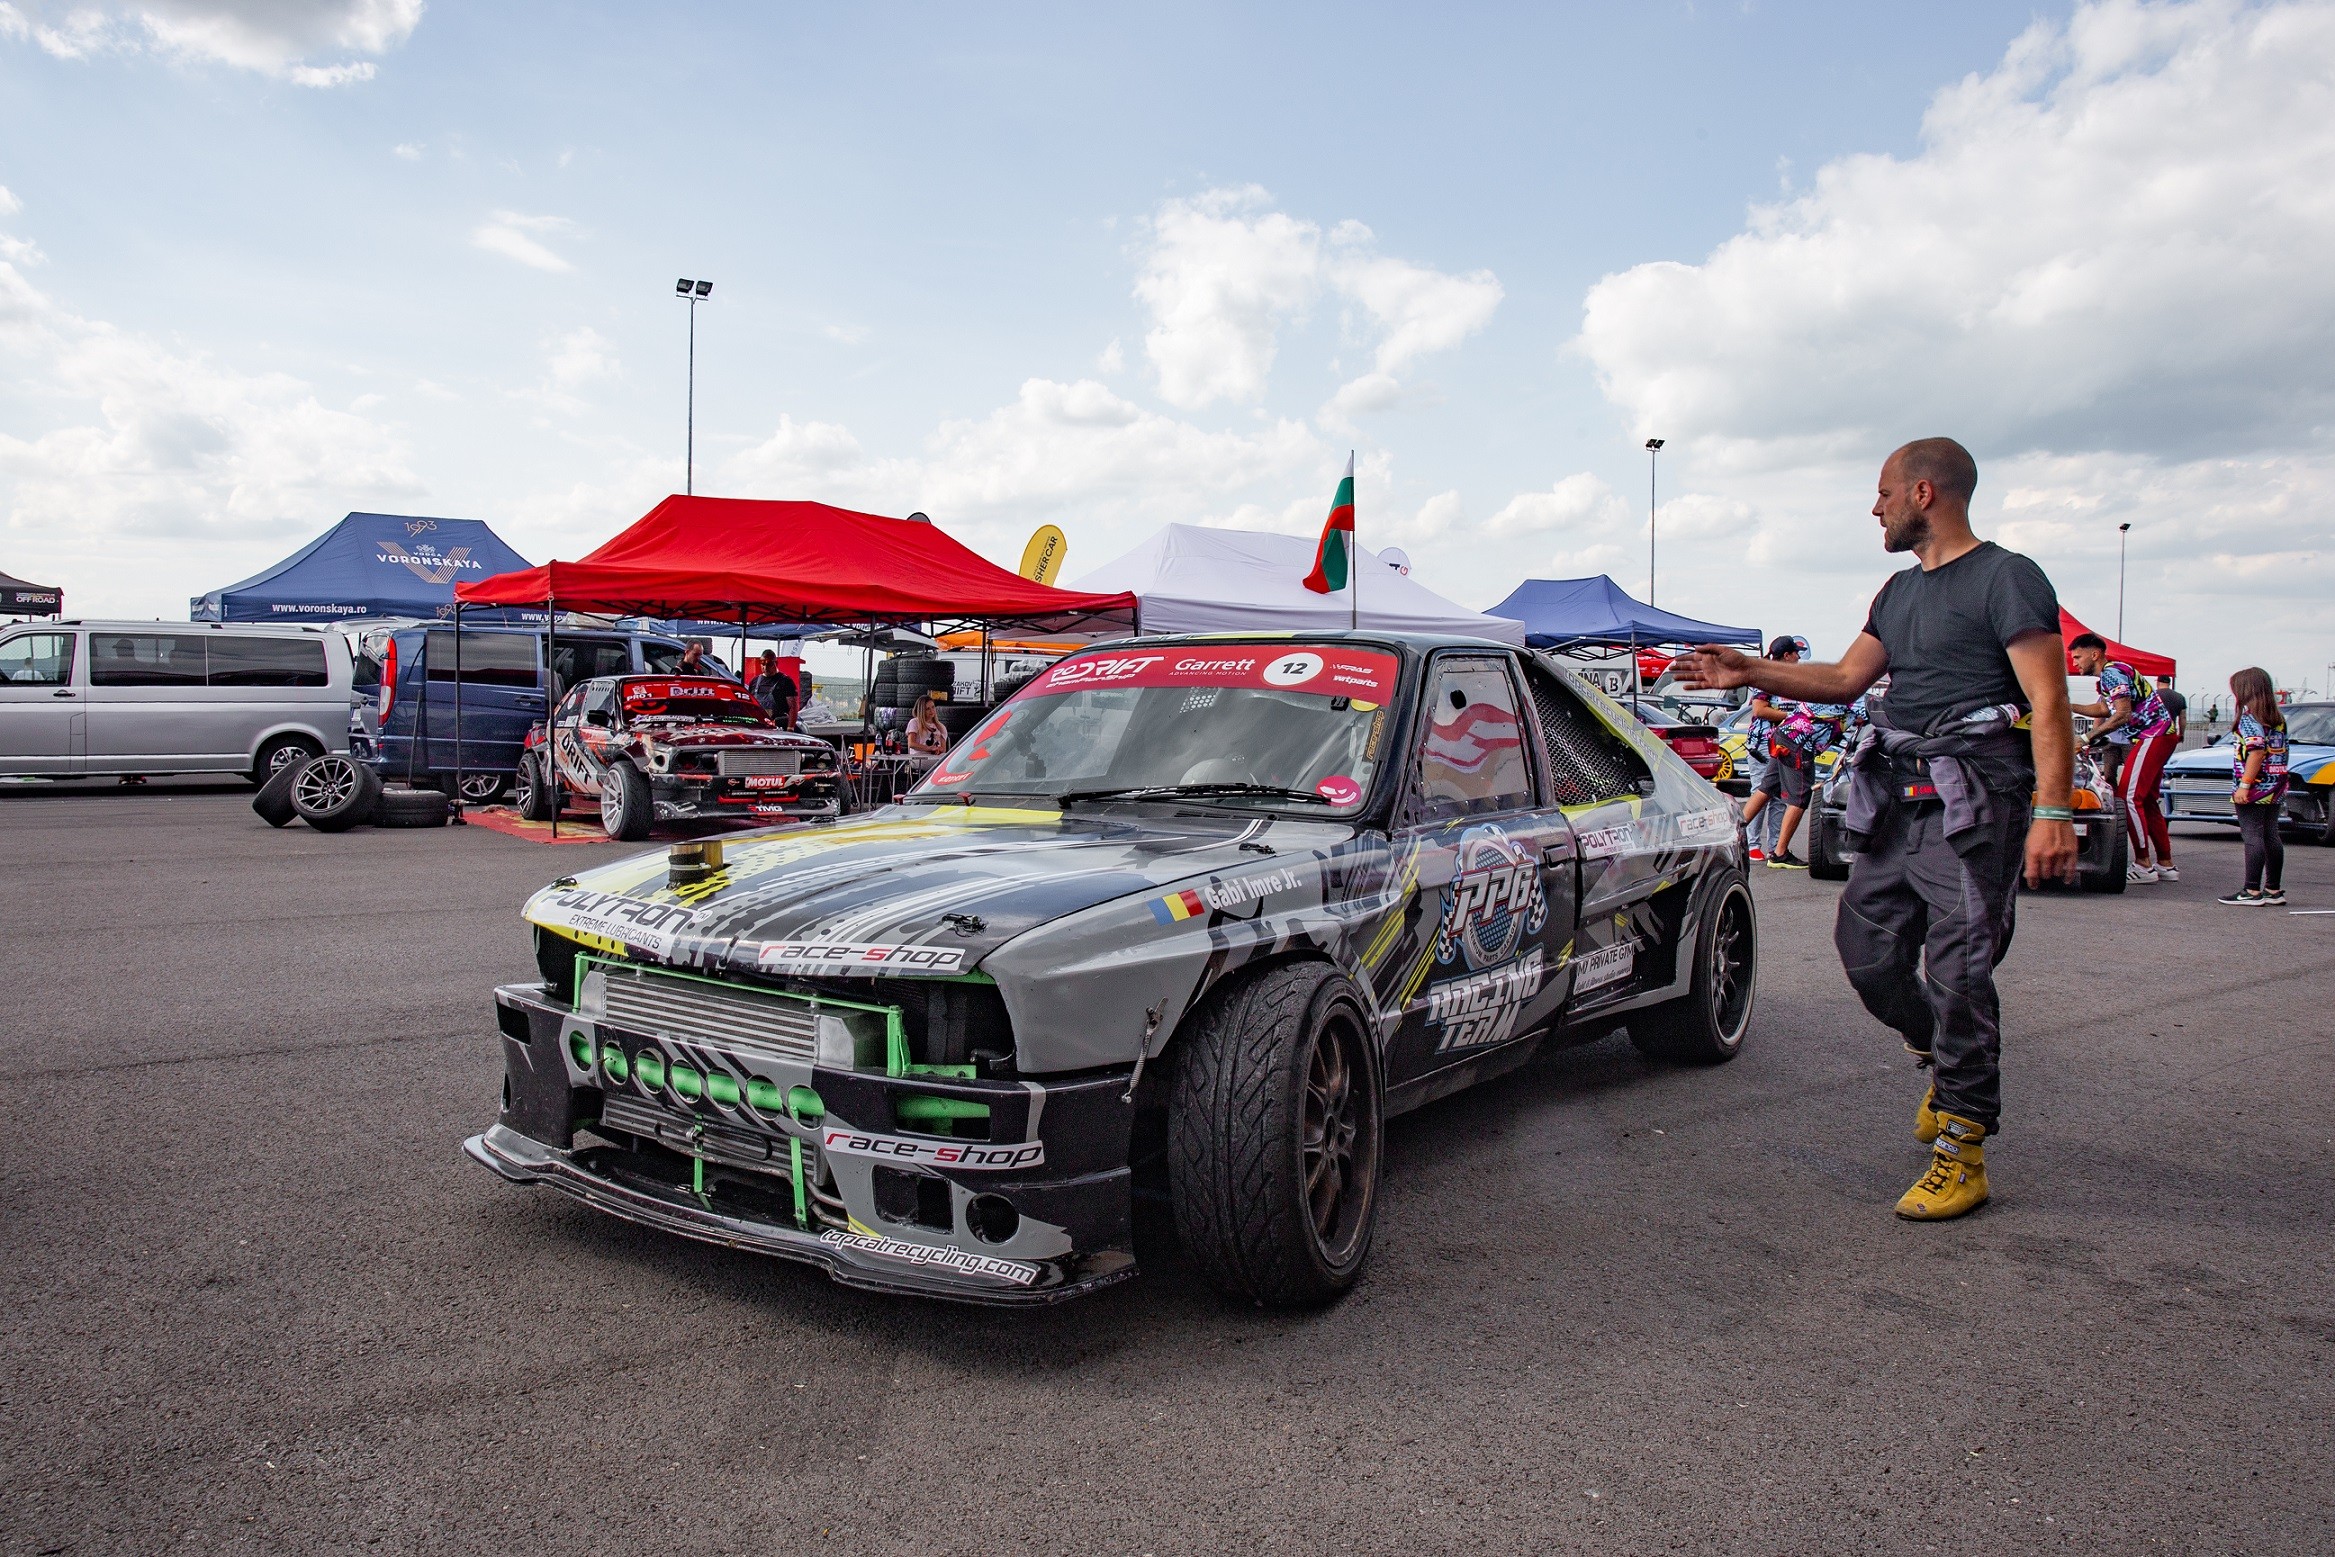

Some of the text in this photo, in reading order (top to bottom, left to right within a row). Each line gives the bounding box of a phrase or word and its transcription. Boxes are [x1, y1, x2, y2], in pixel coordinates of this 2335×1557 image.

[404, 520, 438, 538] 1993
[376, 554, 482, 570] VORONSKAYA
[32, 596, 56, 604] ROAD
[272, 603, 367, 616] www.voronskaya.ro
[1175, 658, 1256, 671] Garrett
[1282, 662, 1309, 675] 12
[562, 732, 592, 785] DRIFT
[749, 776, 784, 788] MOTUL
[1680, 811, 1729, 831] race-shop
[1204, 868, 1302, 910] Gabi Imre Jr.
[1451, 862, 1535, 934] PPG
[547, 888, 694, 934] POLYTRON
[569, 914, 662, 949] EXTREME LUBRICANTS
[760, 945, 962, 969] race-shop
[1589, 949, 1618, 972] PRIVATE
[1428, 948, 1544, 1021] RACING
[1438, 1001, 1522, 1050] TEAM
[826, 1132, 1043, 1168] race-shop
[820, 1229, 1037, 1285] topcatrecycling.com
